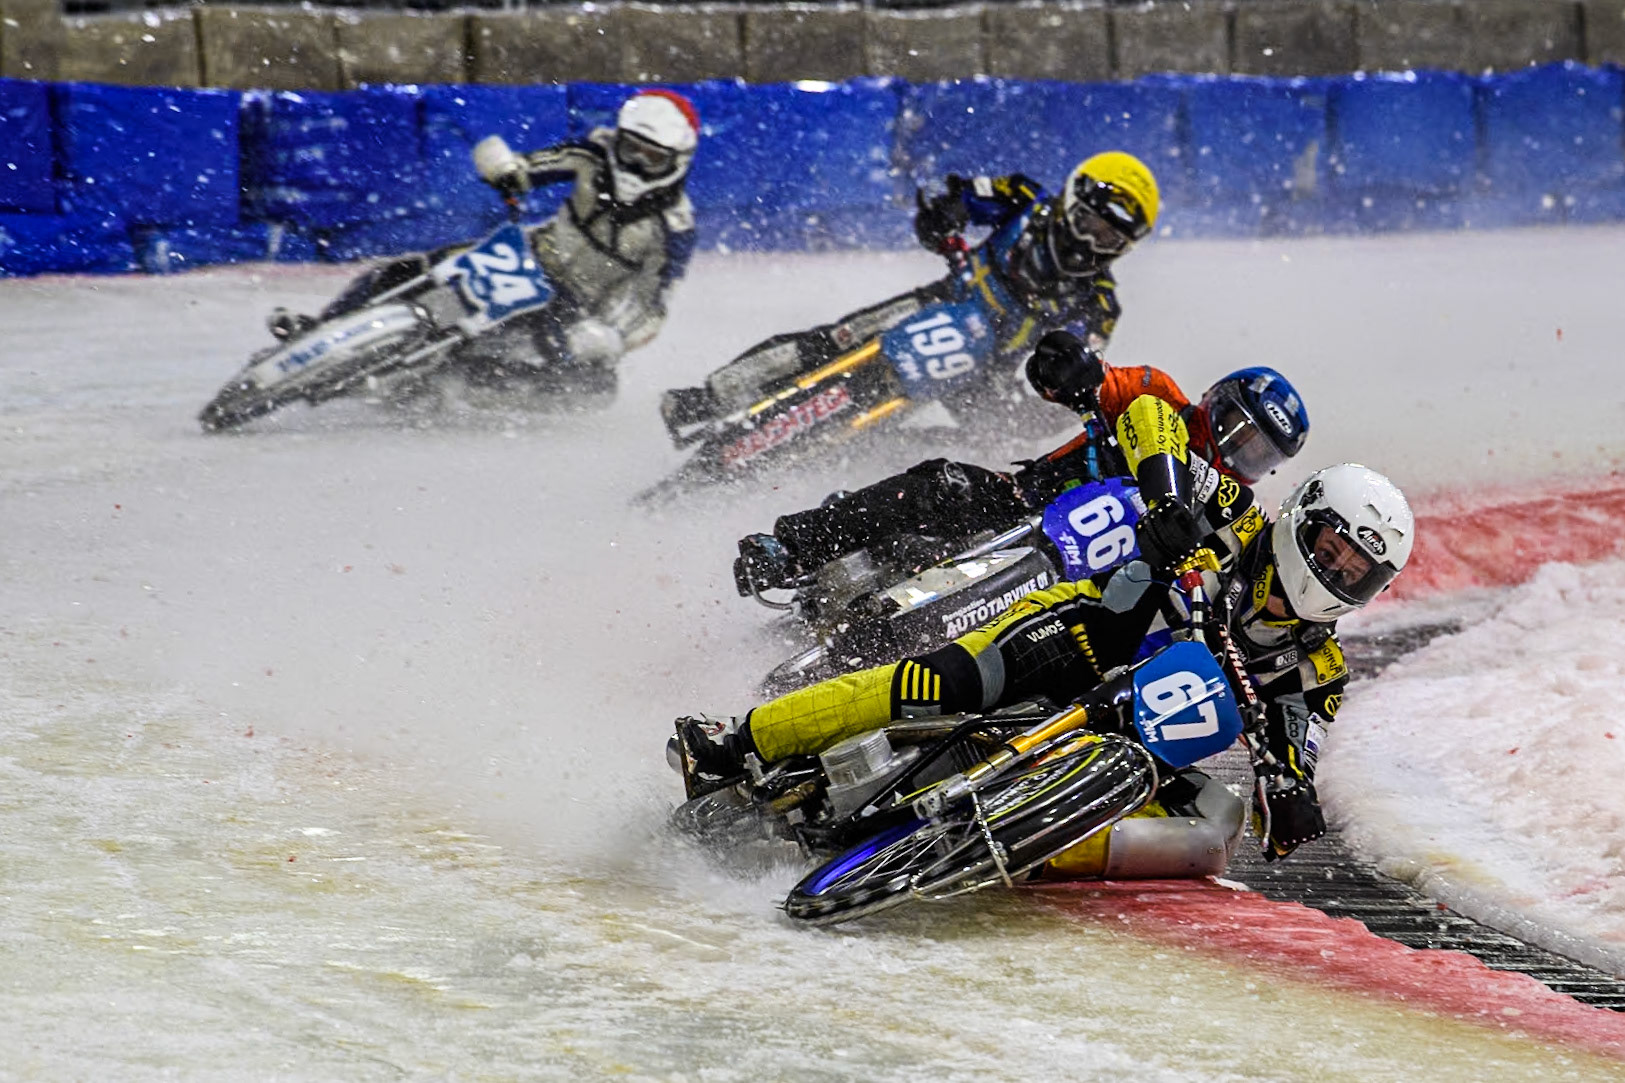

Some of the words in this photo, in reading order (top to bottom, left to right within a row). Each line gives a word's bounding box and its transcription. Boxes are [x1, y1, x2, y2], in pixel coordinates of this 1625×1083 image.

[466, 242, 538, 305] 24
[905, 311, 976, 380] 199
[1061, 533, 1083, 566] FIM
[1068, 494, 1136, 571] 66
[1359, 528, 1386, 555] Airoh
[945, 580, 1038, 639] AUTOTARVIKE
[1218, 623, 1257, 705] ENTHAL
[1141, 670, 1220, 741] 67
